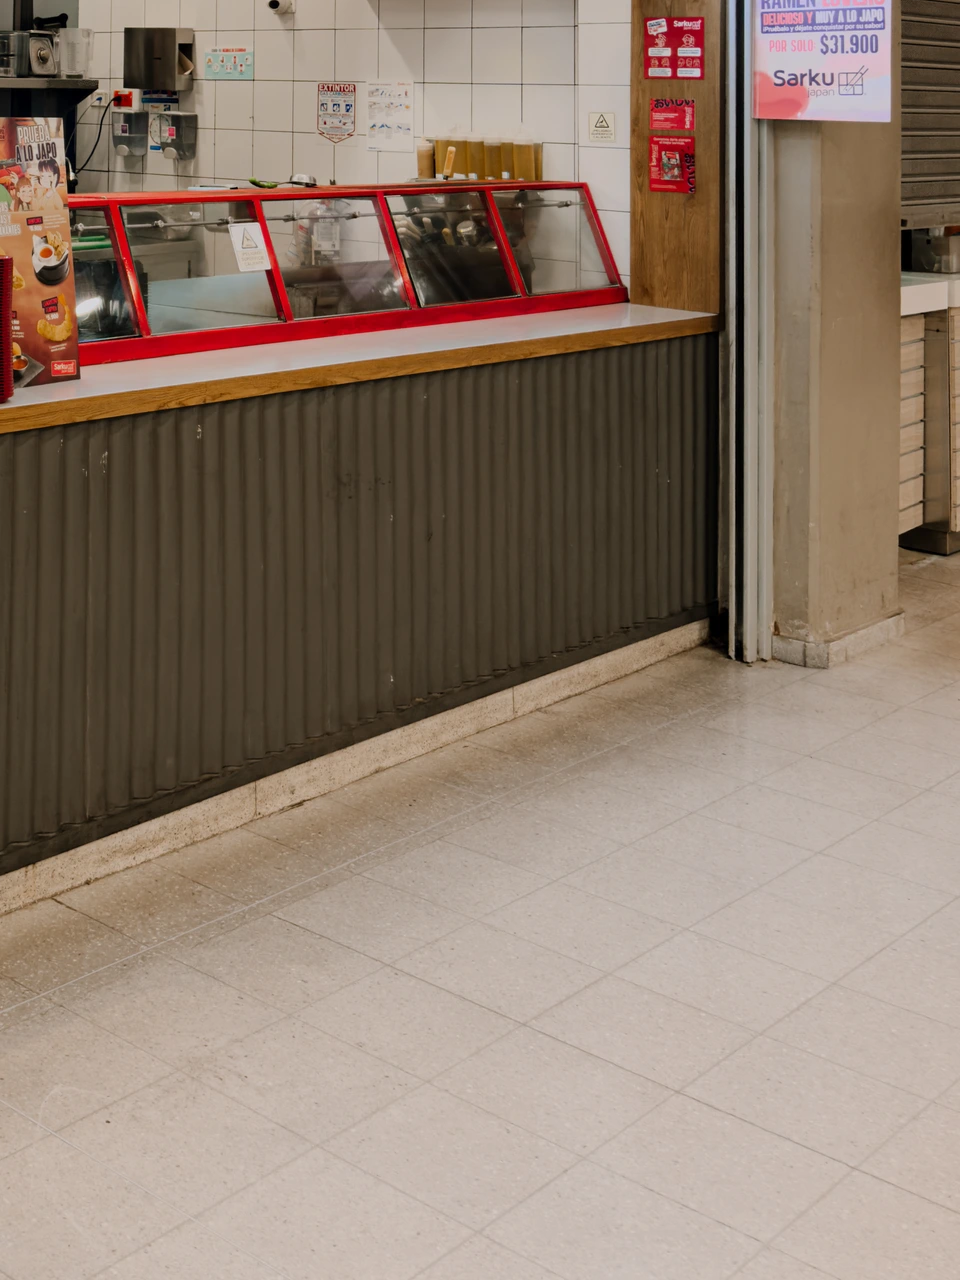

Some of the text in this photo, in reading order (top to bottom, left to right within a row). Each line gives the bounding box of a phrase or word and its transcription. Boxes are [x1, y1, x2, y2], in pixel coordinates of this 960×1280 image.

[762, 8, 883, 26] DELICIOSO Y MUY A LO JAPO
[769, 39, 787, 52] POR
[820, 34, 879, 55] $31.900
[773, 69, 834, 87] Sarku
[320, 84, 355, 92] EXTINTOR
[807, 88, 834, 98] japan
[17, 125, 51, 144] PRUEBA
[16, 142, 57, 163] A LO JAPO
